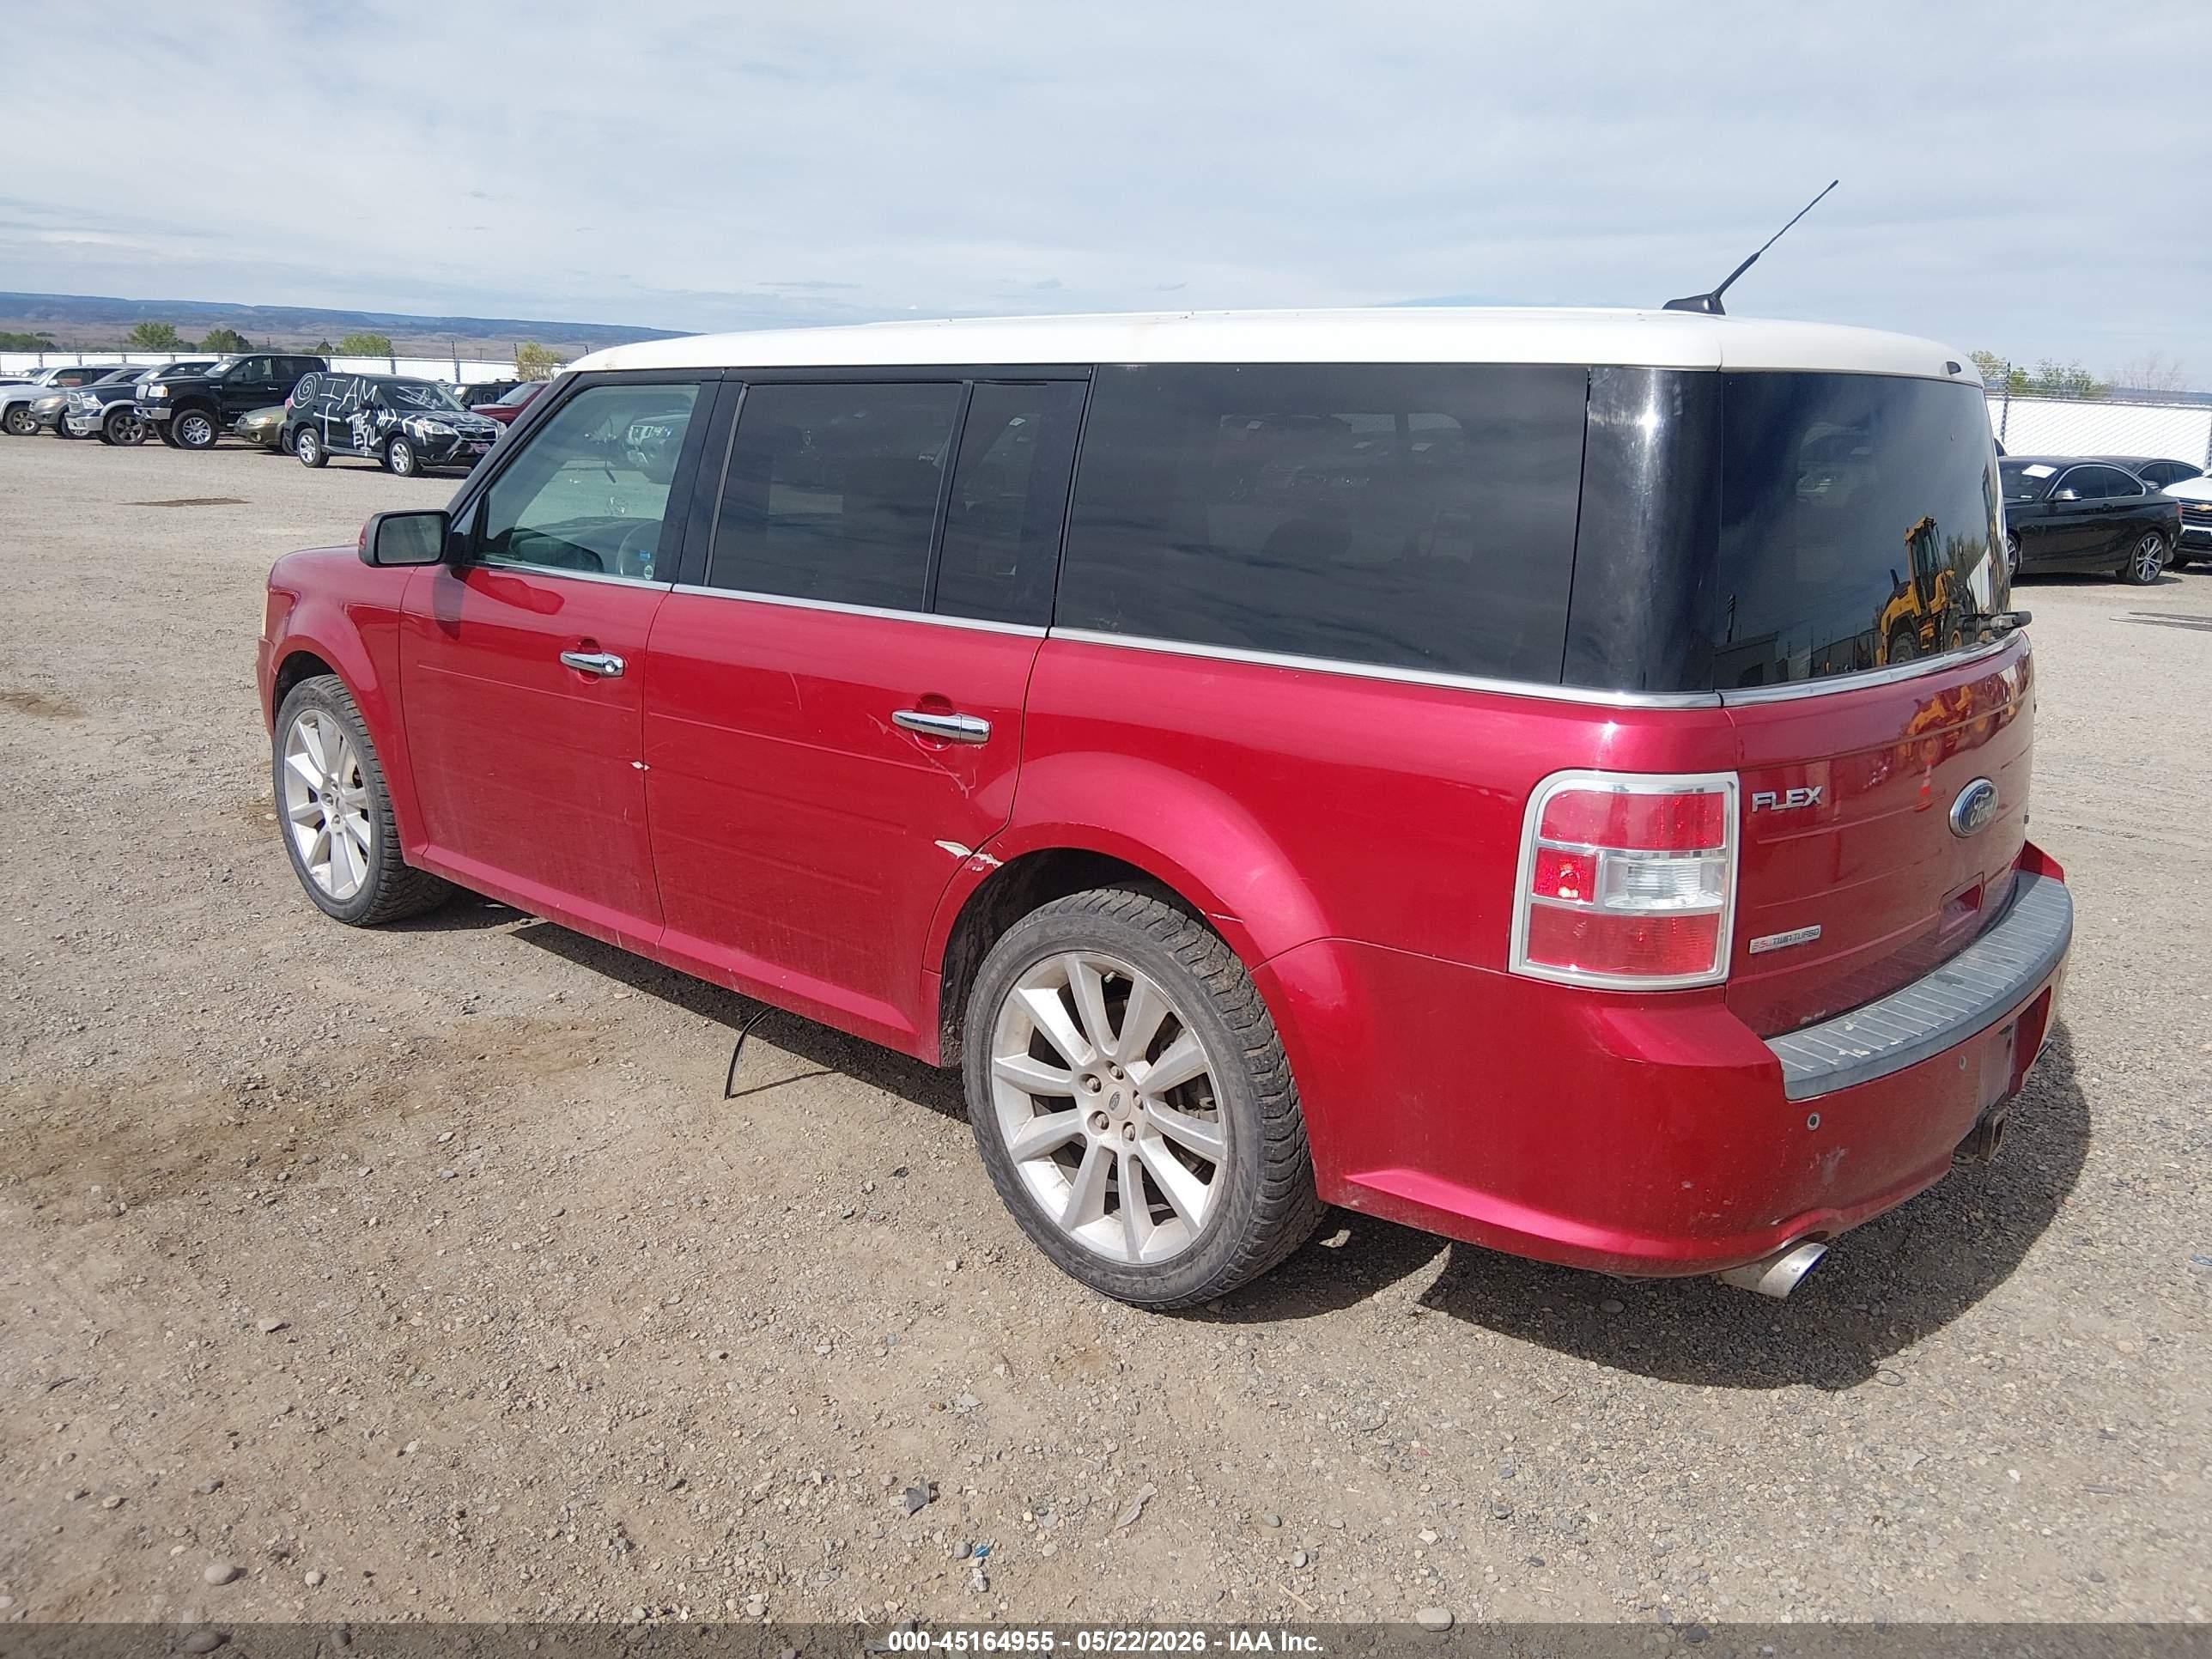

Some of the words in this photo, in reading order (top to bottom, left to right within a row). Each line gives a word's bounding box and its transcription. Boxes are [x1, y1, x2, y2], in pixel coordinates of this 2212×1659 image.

[337, 377, 378, 411] AM
[345, 410, 371, 433] THE
[1752, 786, 1822, 812] FLEX
